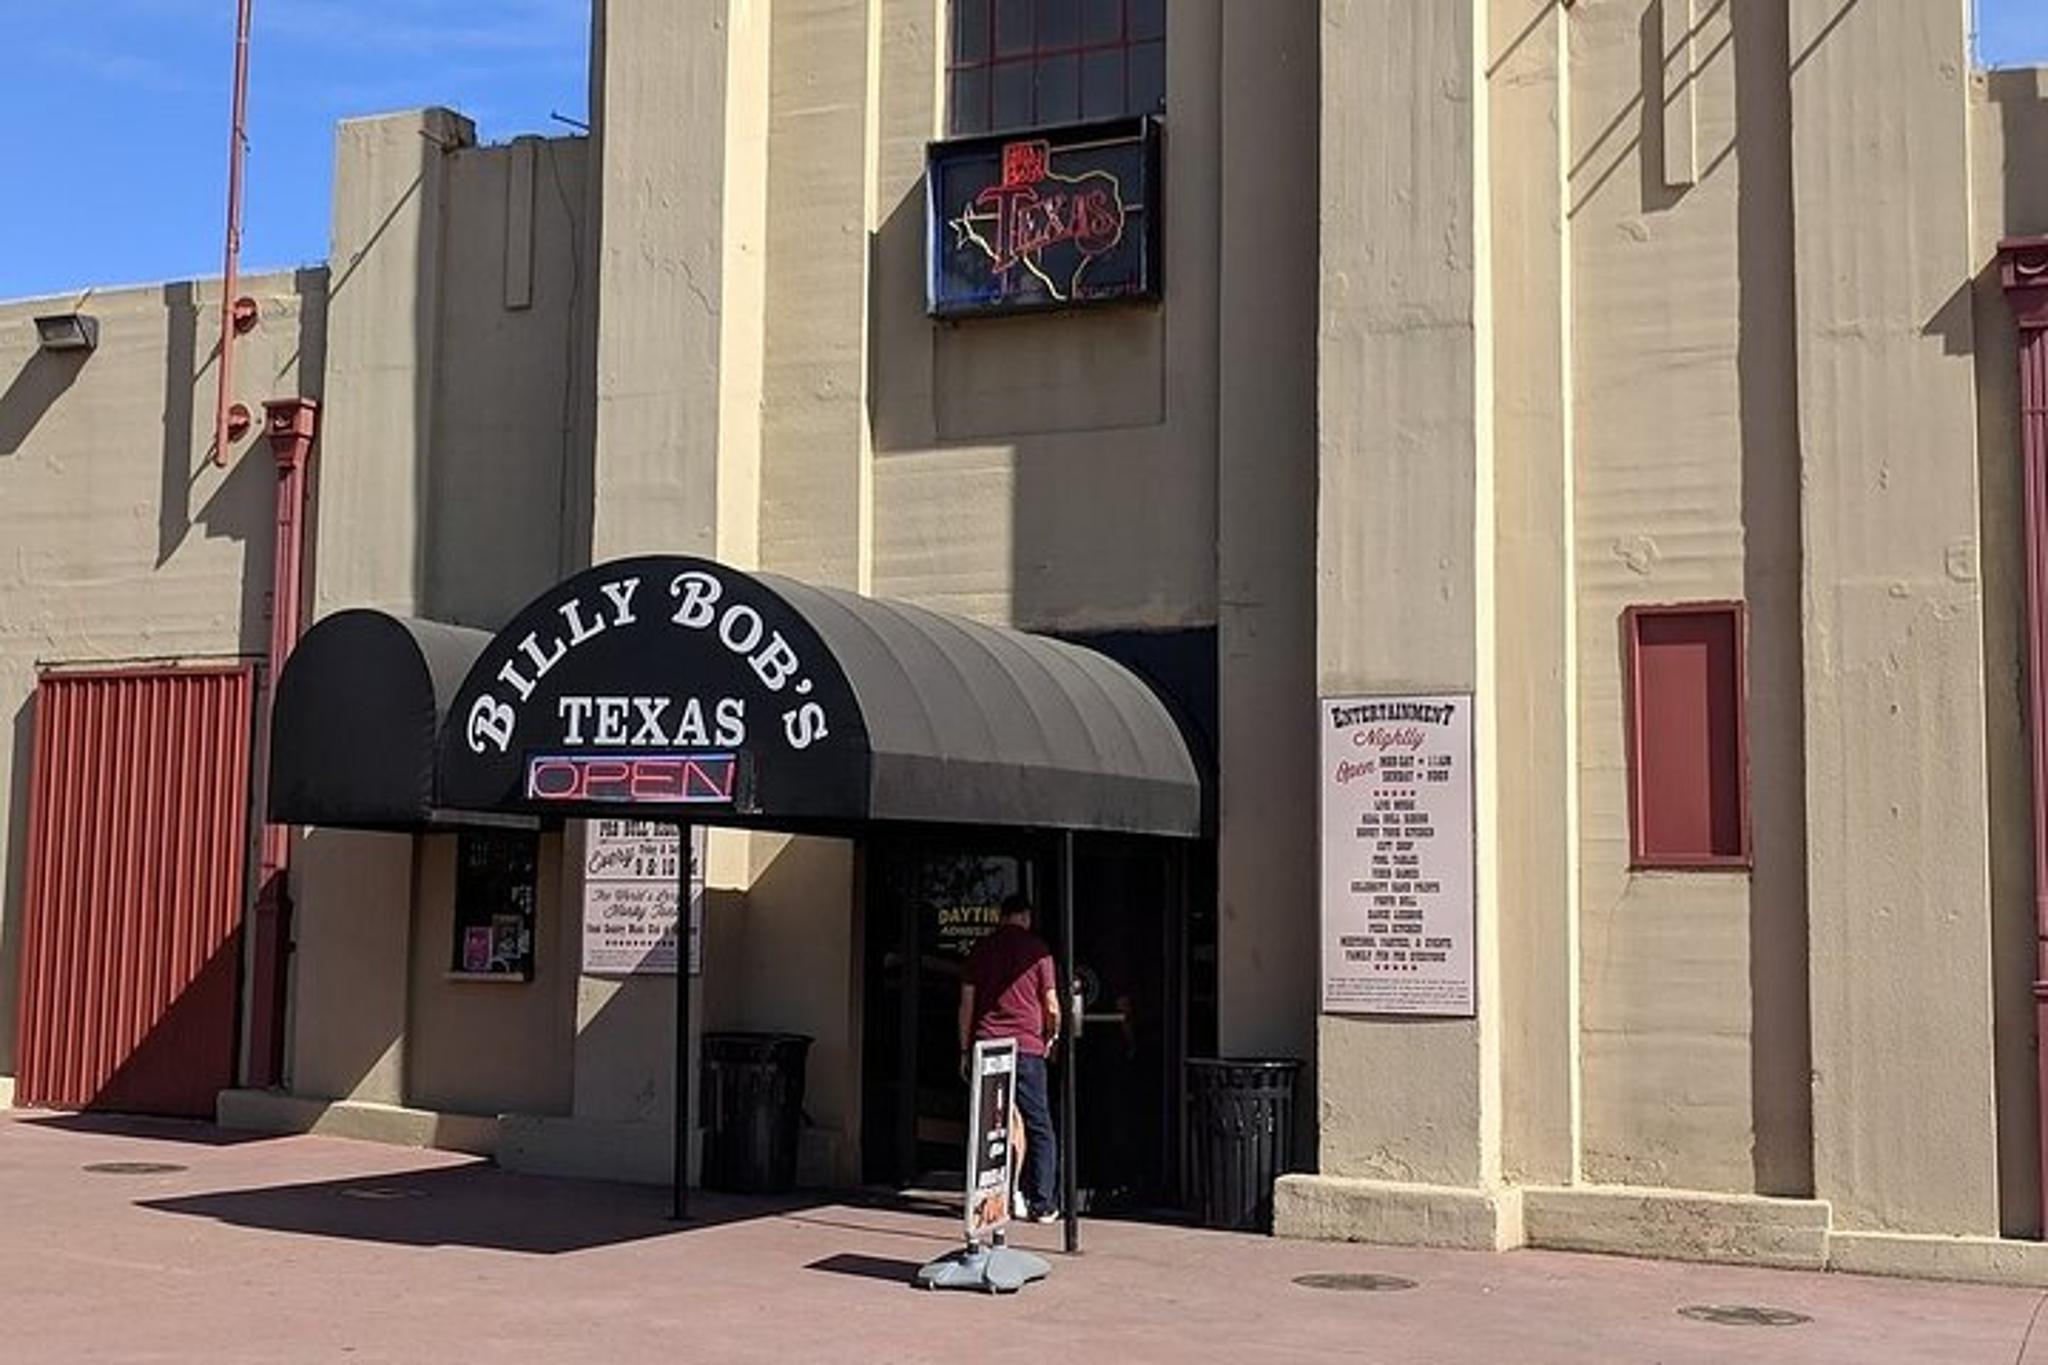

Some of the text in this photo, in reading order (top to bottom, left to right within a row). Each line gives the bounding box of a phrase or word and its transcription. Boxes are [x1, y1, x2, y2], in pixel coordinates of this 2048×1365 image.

[976, 186, 1118, 273] TEXAS
[467, 571, 828, 754] BILLY BOB'S
[559, 697, 746, 747] TEXAS
[1331, 702, 1455, 728] ENTERTAINMENT
[1353, 728, 1425, 751] Nightly
[533, 762, 735, 799] OPEN
[1336, 758, 1377, 784] Open
